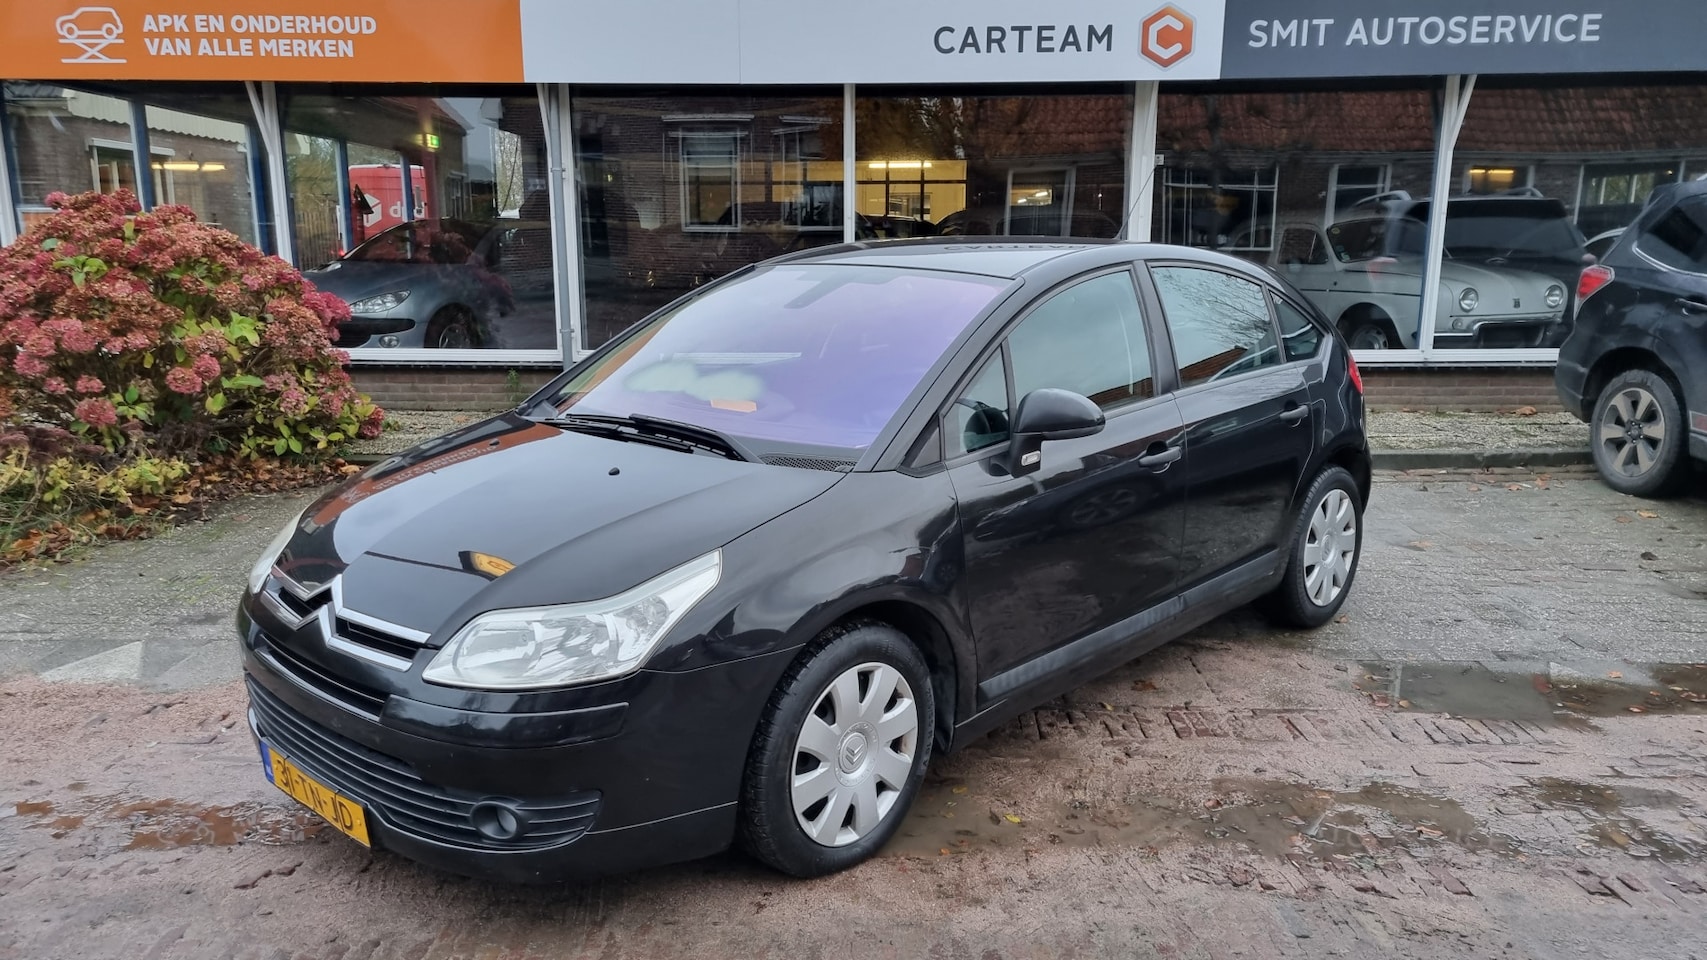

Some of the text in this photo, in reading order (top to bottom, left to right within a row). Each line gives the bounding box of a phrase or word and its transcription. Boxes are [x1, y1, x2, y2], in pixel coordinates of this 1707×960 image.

[143, 14, 377, 35] APK EN ONDERHOUD
[1248, 13, 1603, 48] SMIT AUTOSERVICE
[144, 37, 354, 58] VAN ALLE MERKEN
[933, 24, 1113, 54] CARTEAM
